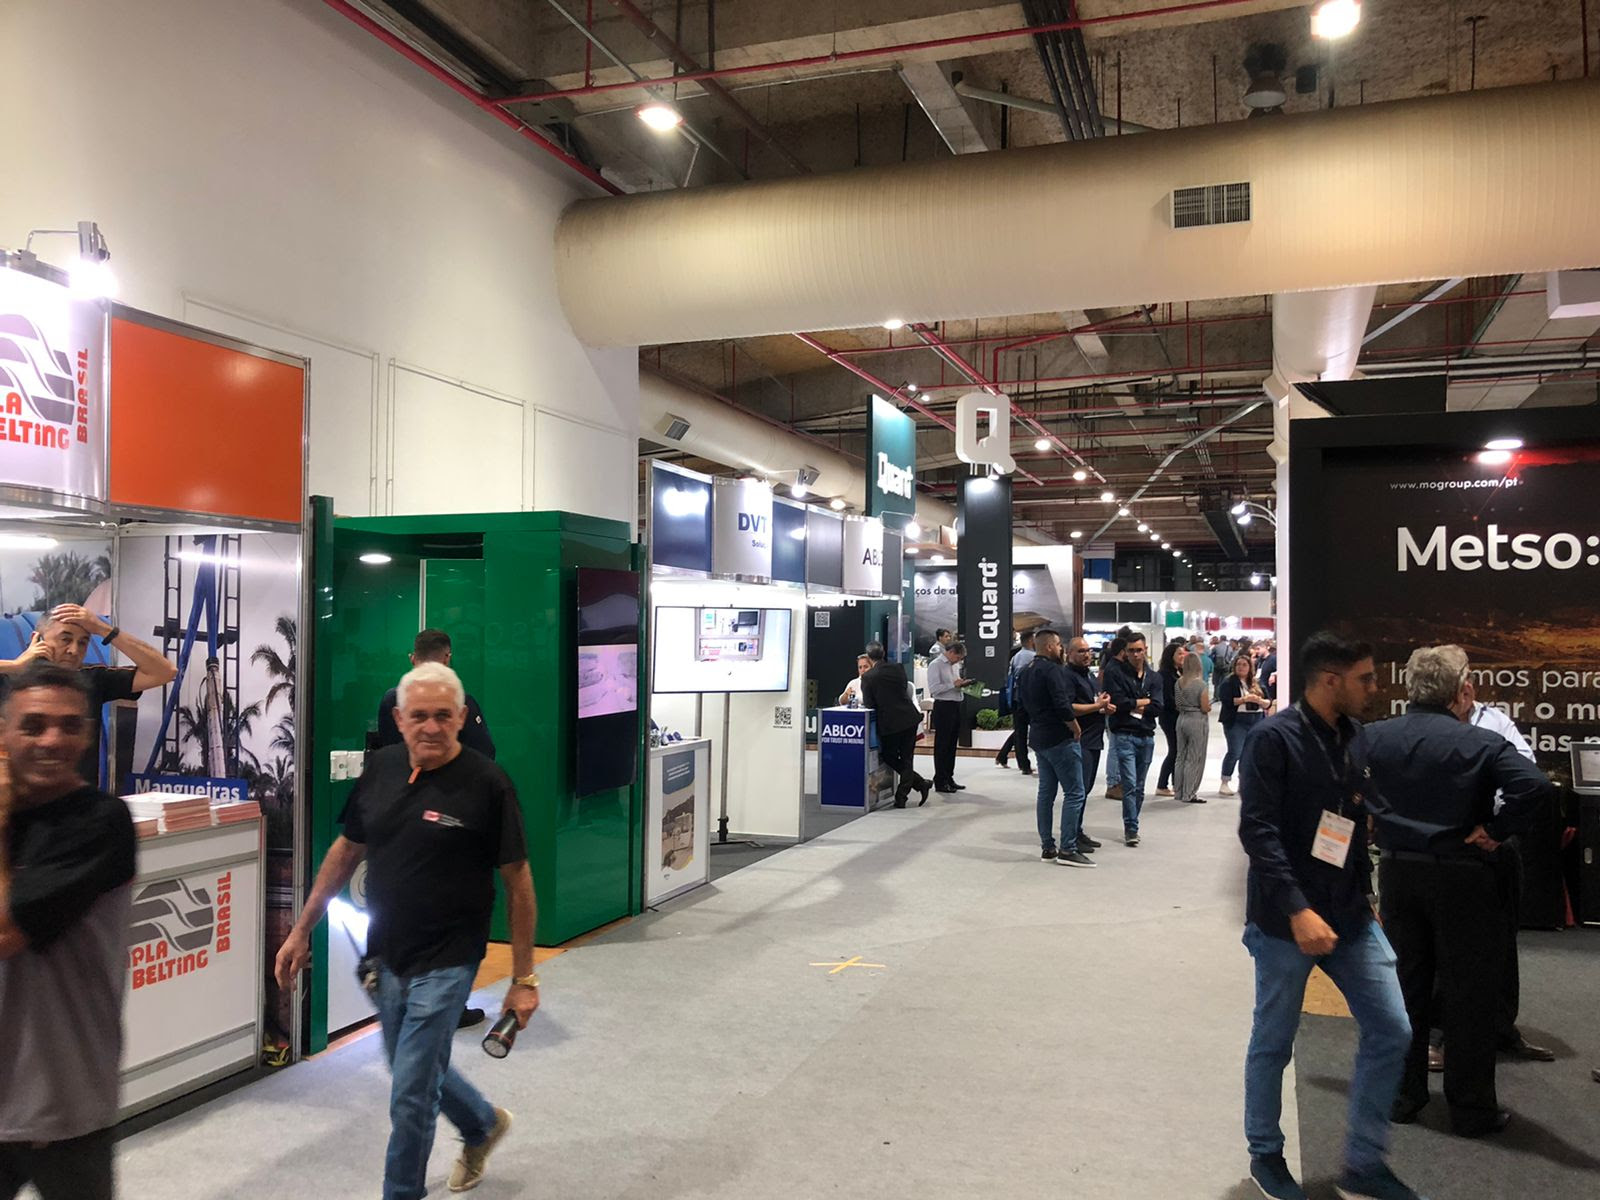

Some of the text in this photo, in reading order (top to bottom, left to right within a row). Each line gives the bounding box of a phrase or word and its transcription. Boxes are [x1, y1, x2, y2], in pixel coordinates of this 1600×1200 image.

[955, 392, 1016, 474] Q
[1389, 477, 1518, 490] www.mogroup.com/pt
[933, 585, 947, 595] de
[978, 561, 1000, 639] Quard
[1535, 702, 1555, 720] o
[822, 724, 864, 737] ABLOY
